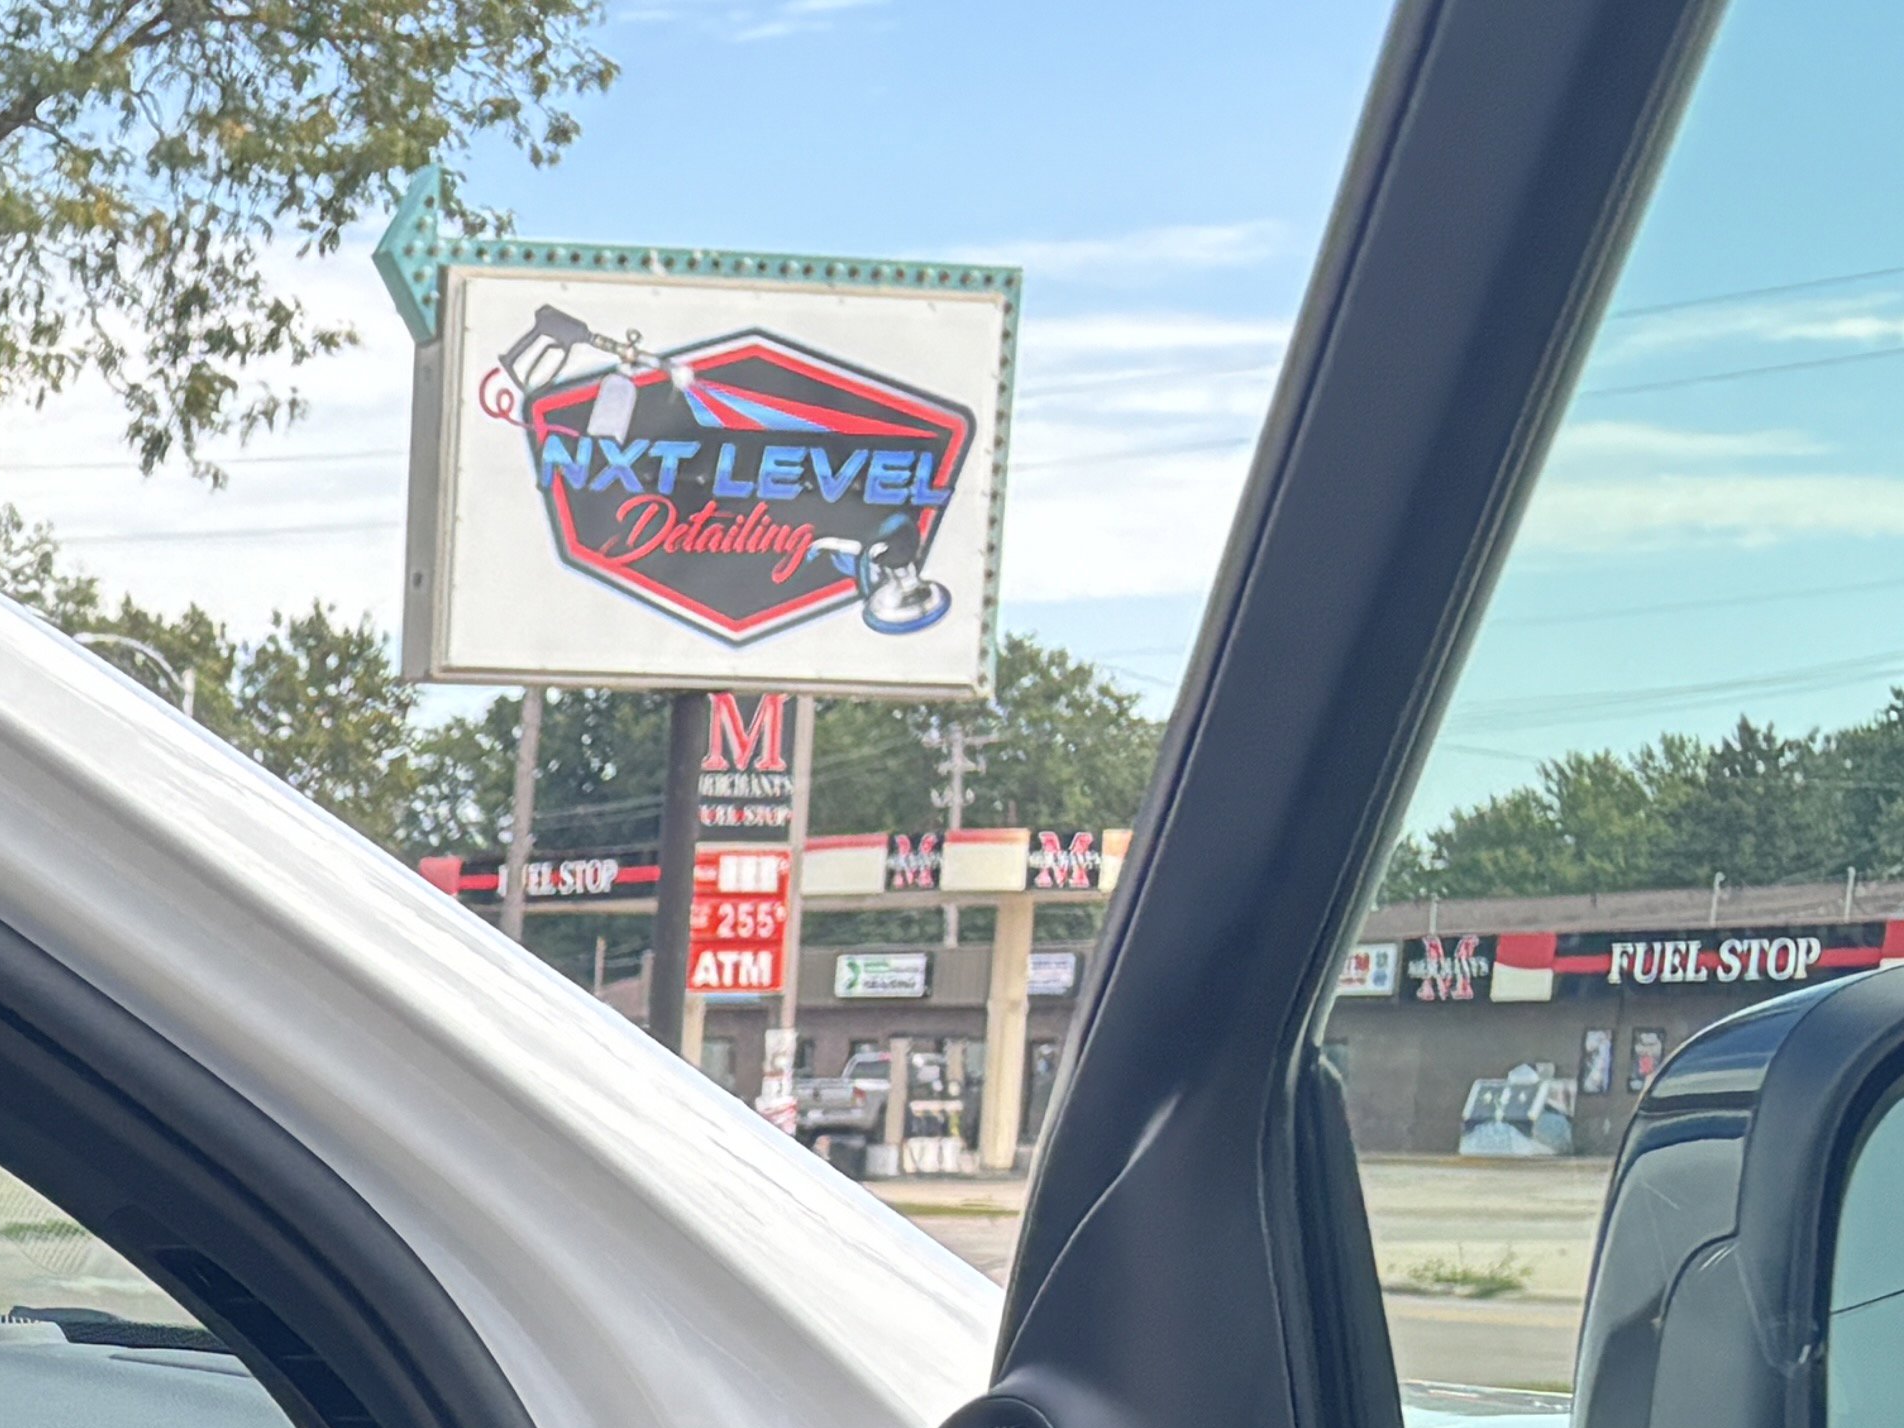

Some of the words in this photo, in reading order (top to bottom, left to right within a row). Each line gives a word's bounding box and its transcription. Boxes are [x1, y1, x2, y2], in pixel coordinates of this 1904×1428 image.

[541, 438, 700, 495] NXT
[712, 442, 954, 506] LEVEL
[600, 494, 814, 584] Detailing
[700, 691, 790, 772] M
[497, 861, 558, 897] FEL
[558, 858, 619, 896] STOP
[693, 950, 773, 987] ATM
[1608, 942, 1705, 984] FUEL
[1717, 937, 1821, 983] STOP
